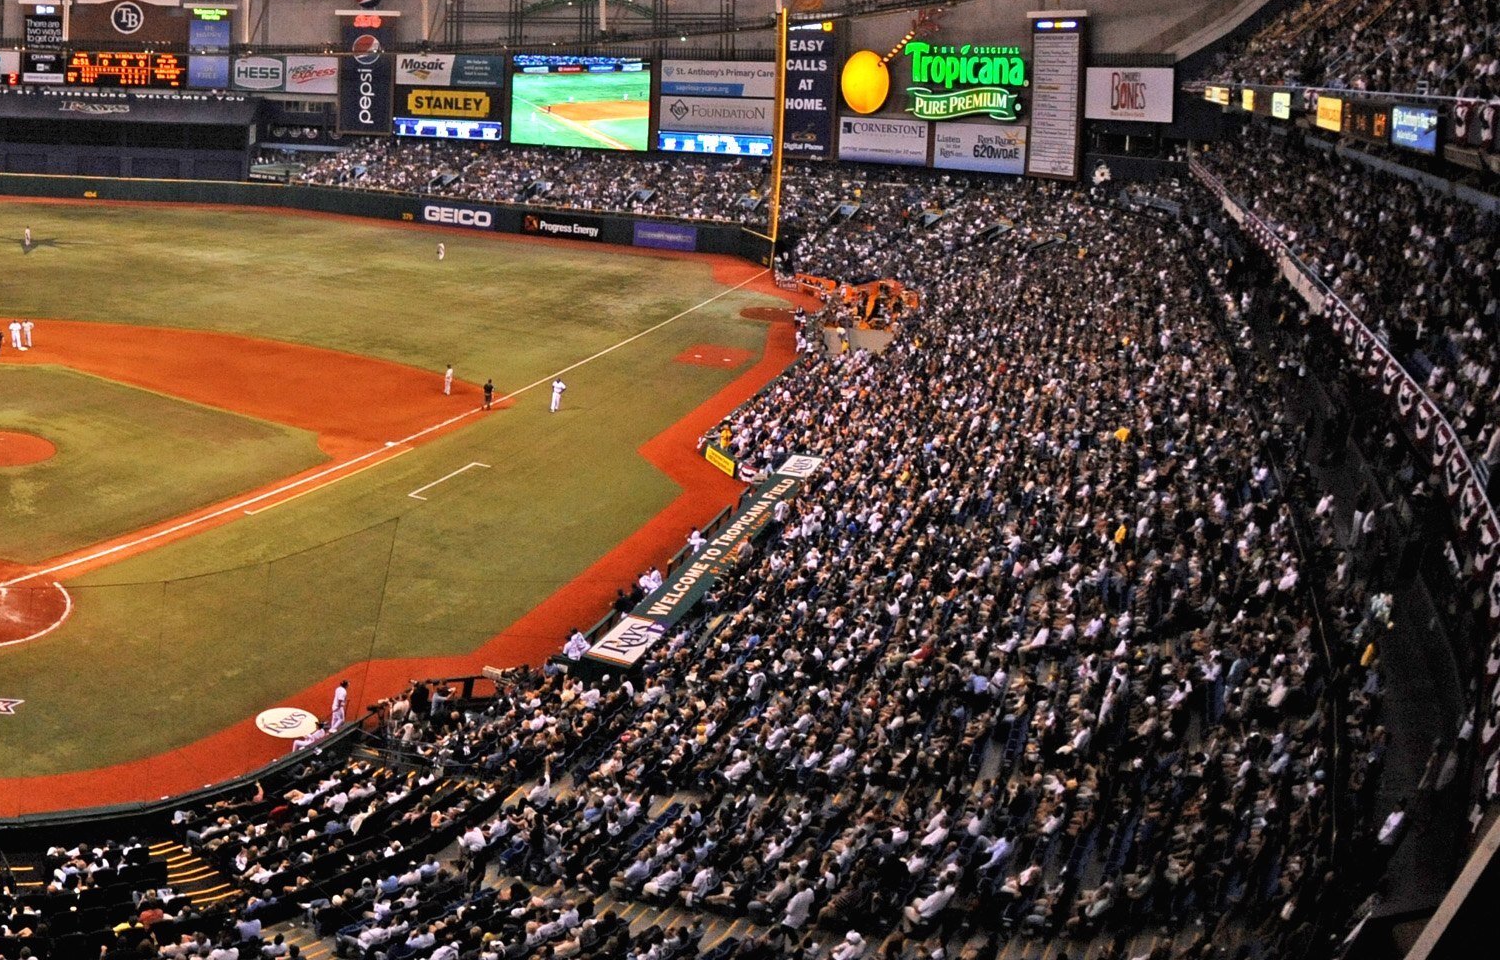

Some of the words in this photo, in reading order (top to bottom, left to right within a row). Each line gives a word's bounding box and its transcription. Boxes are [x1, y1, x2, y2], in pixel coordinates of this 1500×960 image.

[26, 19, 47, 28] There
[35, 35, 47, 44] get
[41, 29, 61, 38] ways
[789, 40, 824, 52] EASY
[933, 46, 955, 54] THE
[973, 46, 1020, 55] ORIGINAL
[401, 58, 446, 71] Mosaic
[786, 59, 827, 71] CALLS
[905, 41, 1025, 89] Tropicana
[237, 67, 280, 79] HESS
[676, 67, 686, 76] St.
[687, 67, 724, 78] Anthony's
[725, 69, 755, 79] Primary
[756, 69, 774, 78] Care
[798, 79, 814, 91] AT
[136, 93, 209, 101] WELCOMES
[357, 68, 375, 125] pepsi
[414, 96, 483, 111] STANLEY
[785, 98, 827, 111] HOME.
[915, 96, 948, 115] PURE
[948, 92, 1008, 113] PREMIUM
[852, 122, 926, 138] CORNERSTONE
[937, 134, 961, 143] Listen
[804, 143, 824, 151] Phone
[424, 205, 492, 227] GEICO
[540, 220, 572, 234] Progress
[573, 221, 599, 237] Energy
[762, 478, 795, 501] FIELD
[710, 499, 772, 551] TROPICANA
[703, 548, 722, 562] TO
[647, 558, 709, 616] WELCOME
